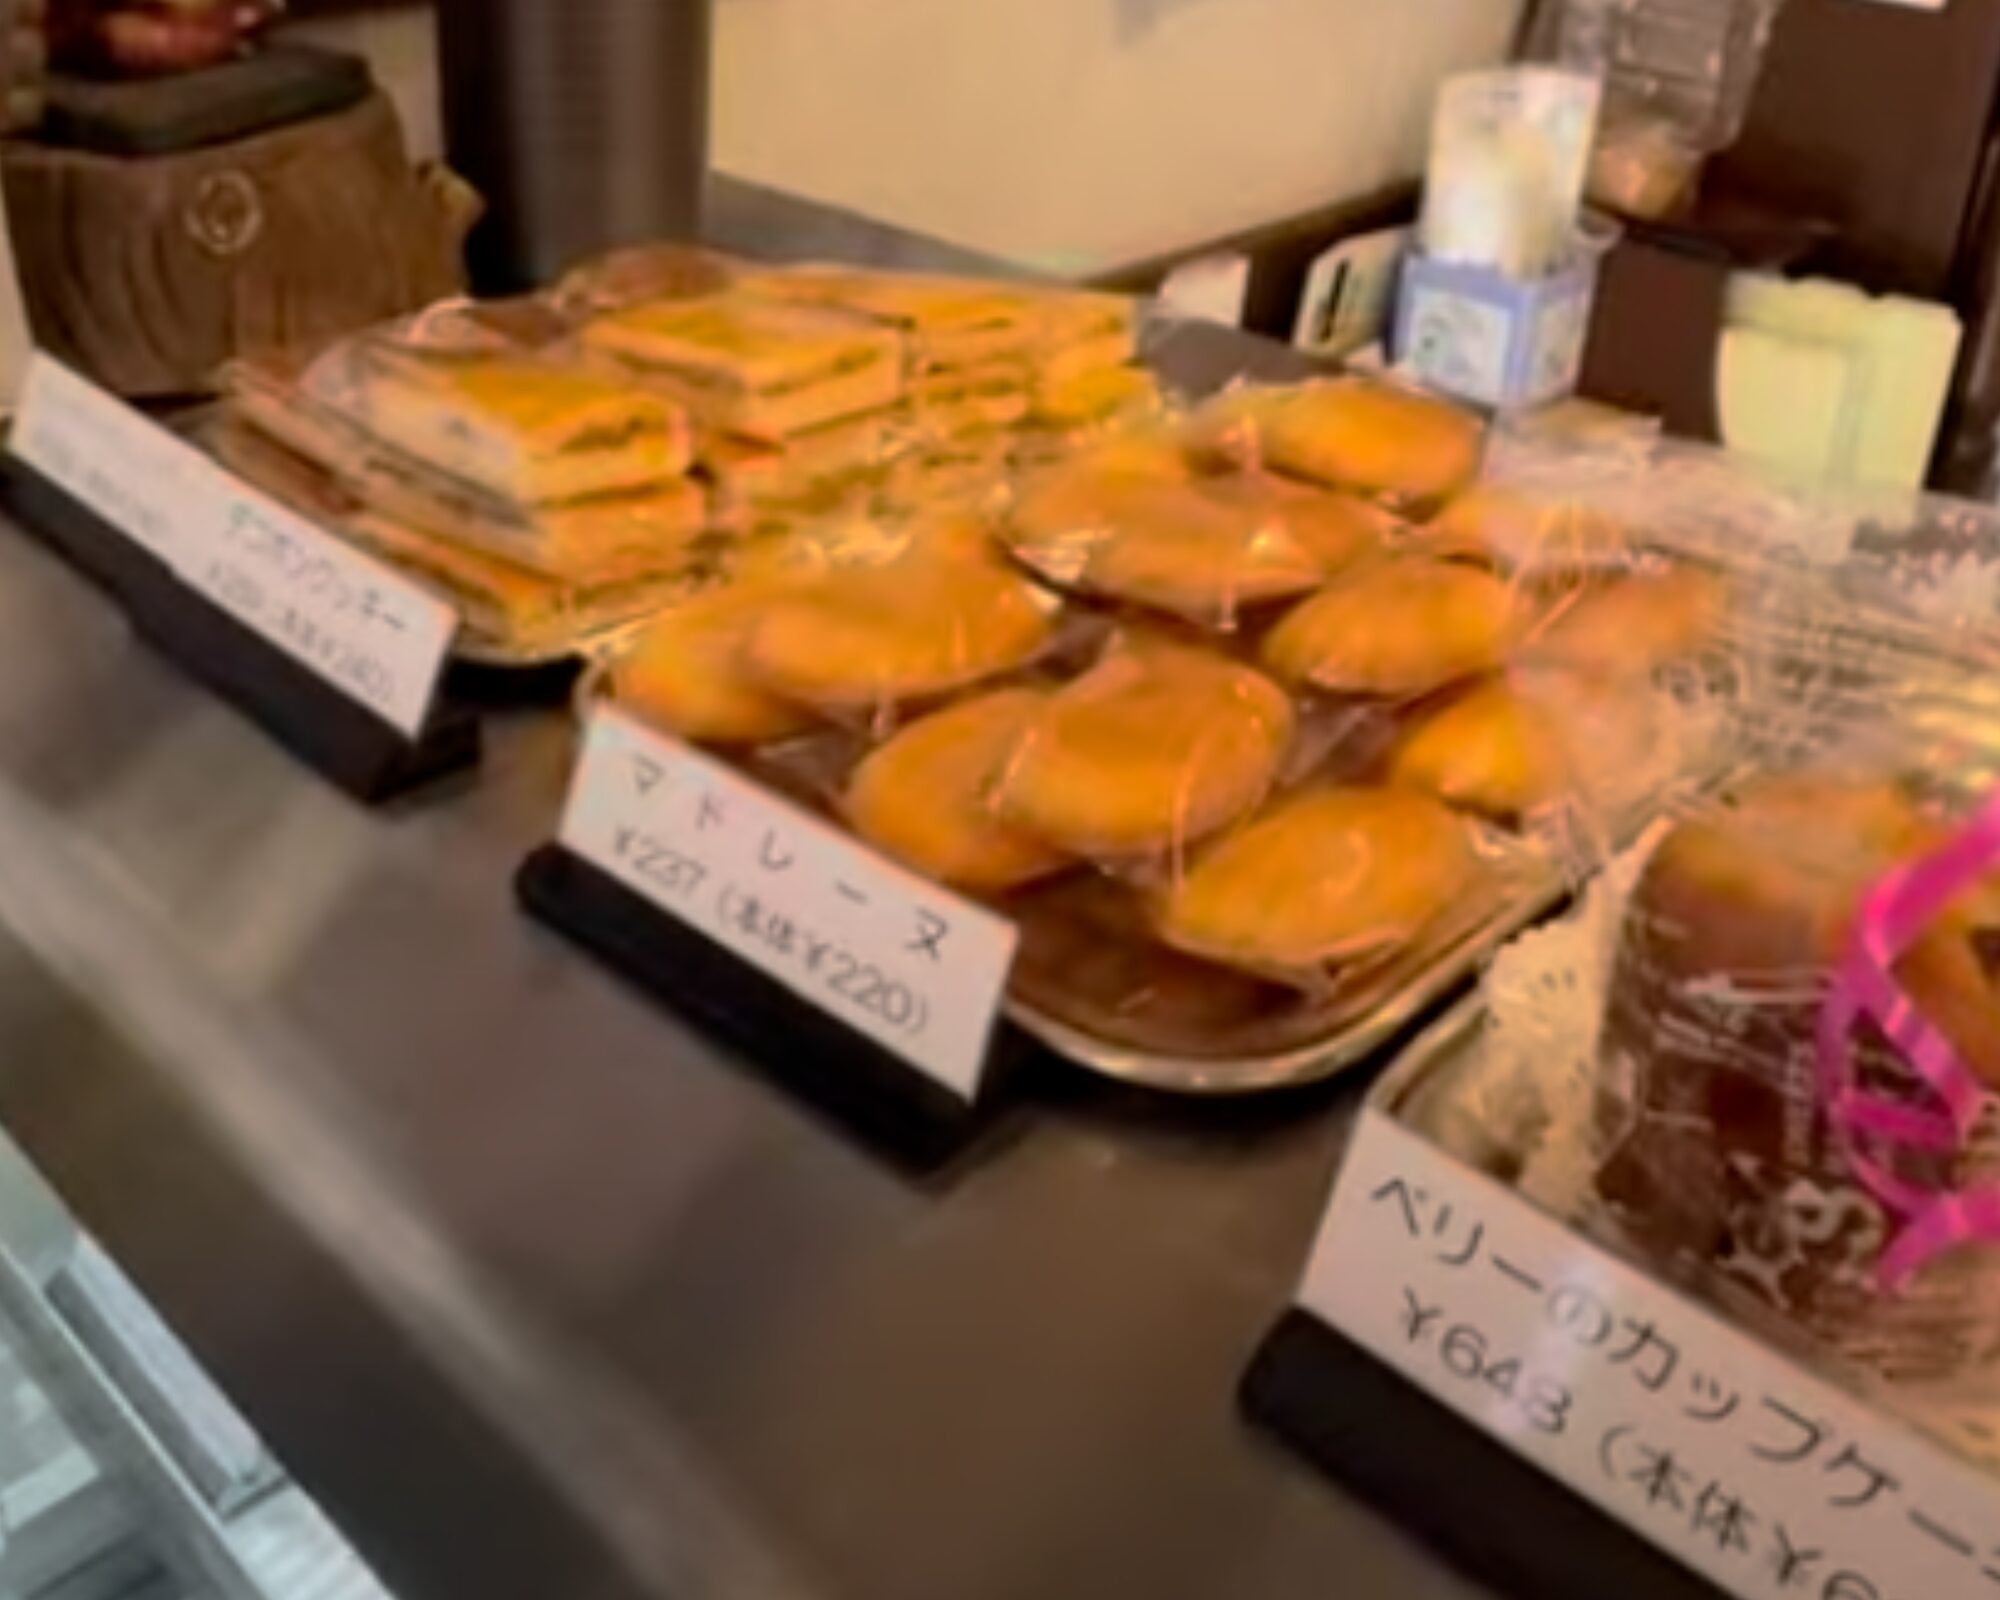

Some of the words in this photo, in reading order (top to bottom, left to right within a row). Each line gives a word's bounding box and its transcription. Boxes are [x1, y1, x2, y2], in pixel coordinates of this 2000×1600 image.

[613, 826, 707, 896] ¥237
[632, 753, 952, 961] マドレーヌ
[1401, 1282, 1573, 1435] ¥648
